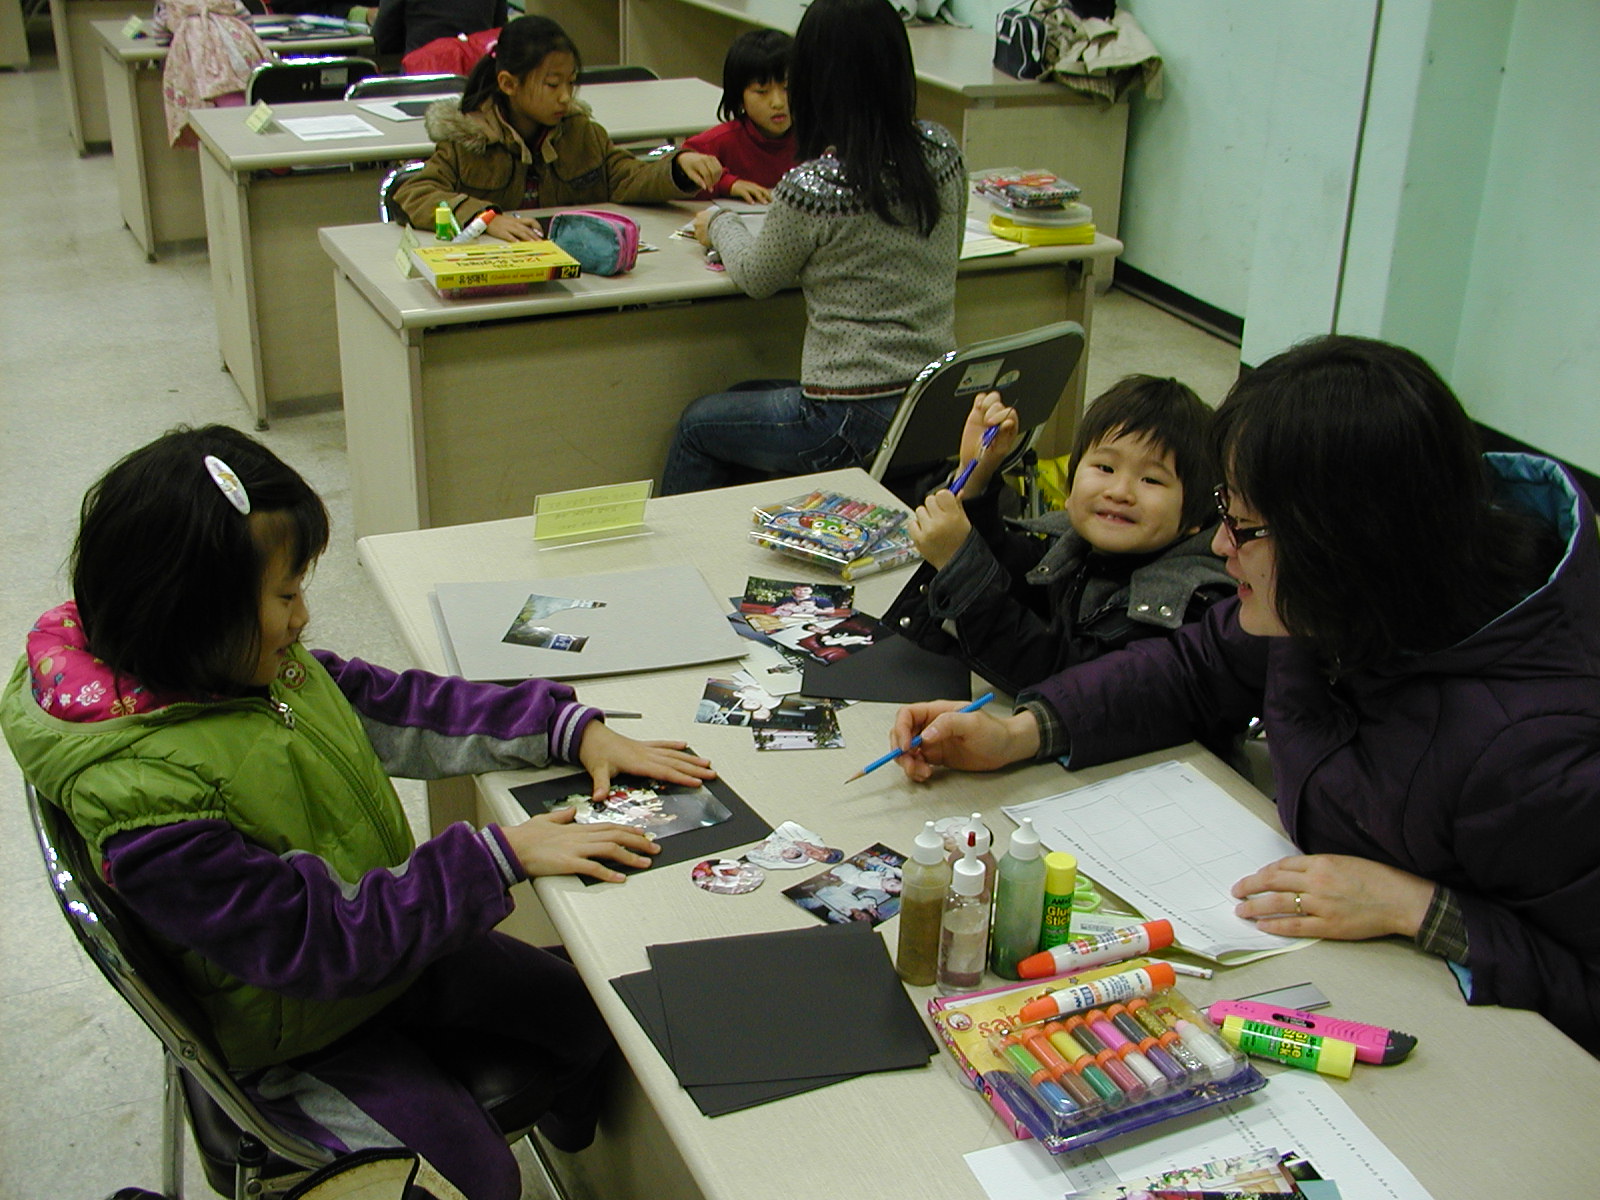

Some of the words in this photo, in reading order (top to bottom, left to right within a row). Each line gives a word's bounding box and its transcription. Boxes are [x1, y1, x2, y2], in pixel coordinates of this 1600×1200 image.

[560, 265, 580, 279] 12+1
[1278, 1028, 1295, 1056] Stick
[1291, 1031, 1309, 1059] Glue
